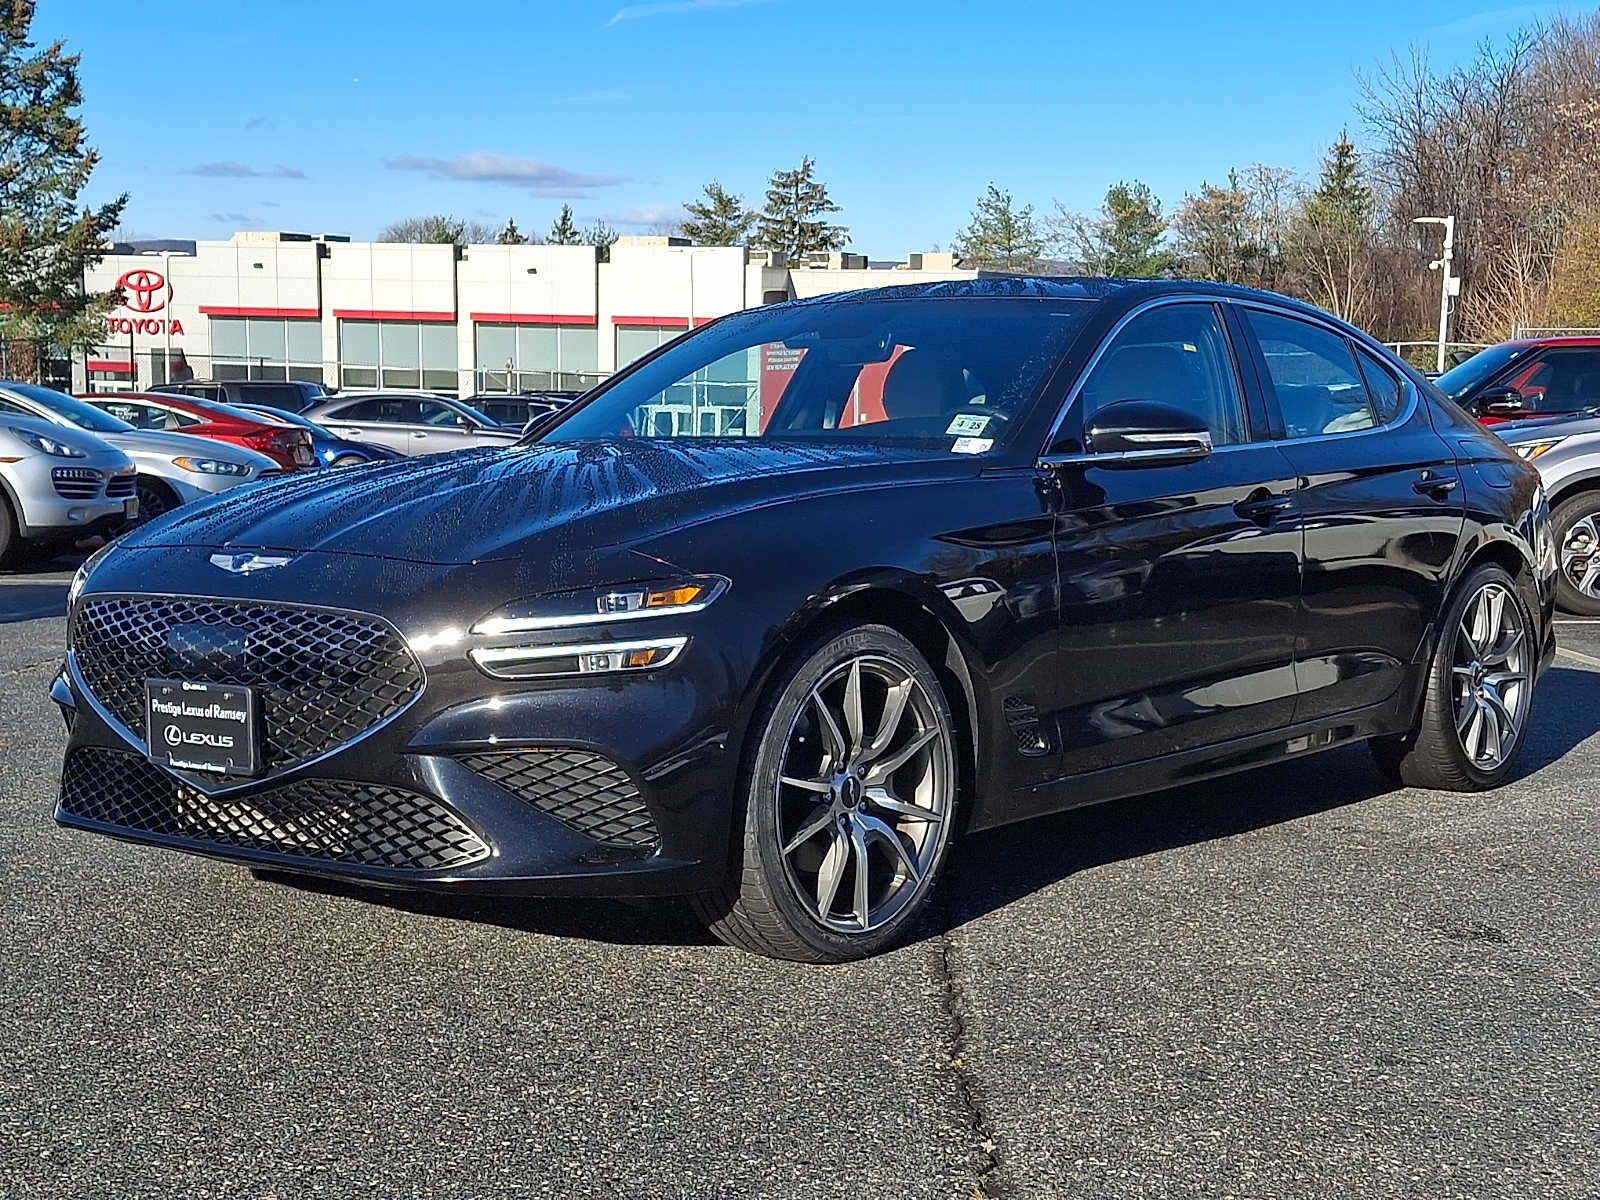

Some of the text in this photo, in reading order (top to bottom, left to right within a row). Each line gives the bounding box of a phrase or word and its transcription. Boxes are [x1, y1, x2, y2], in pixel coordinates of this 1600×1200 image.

[107, 318, 184, 335] TOYOTA
[152, 698, 247, 723] Prestige Lexus of Ramsey
[183, 731, 234, 747] LEXUS
